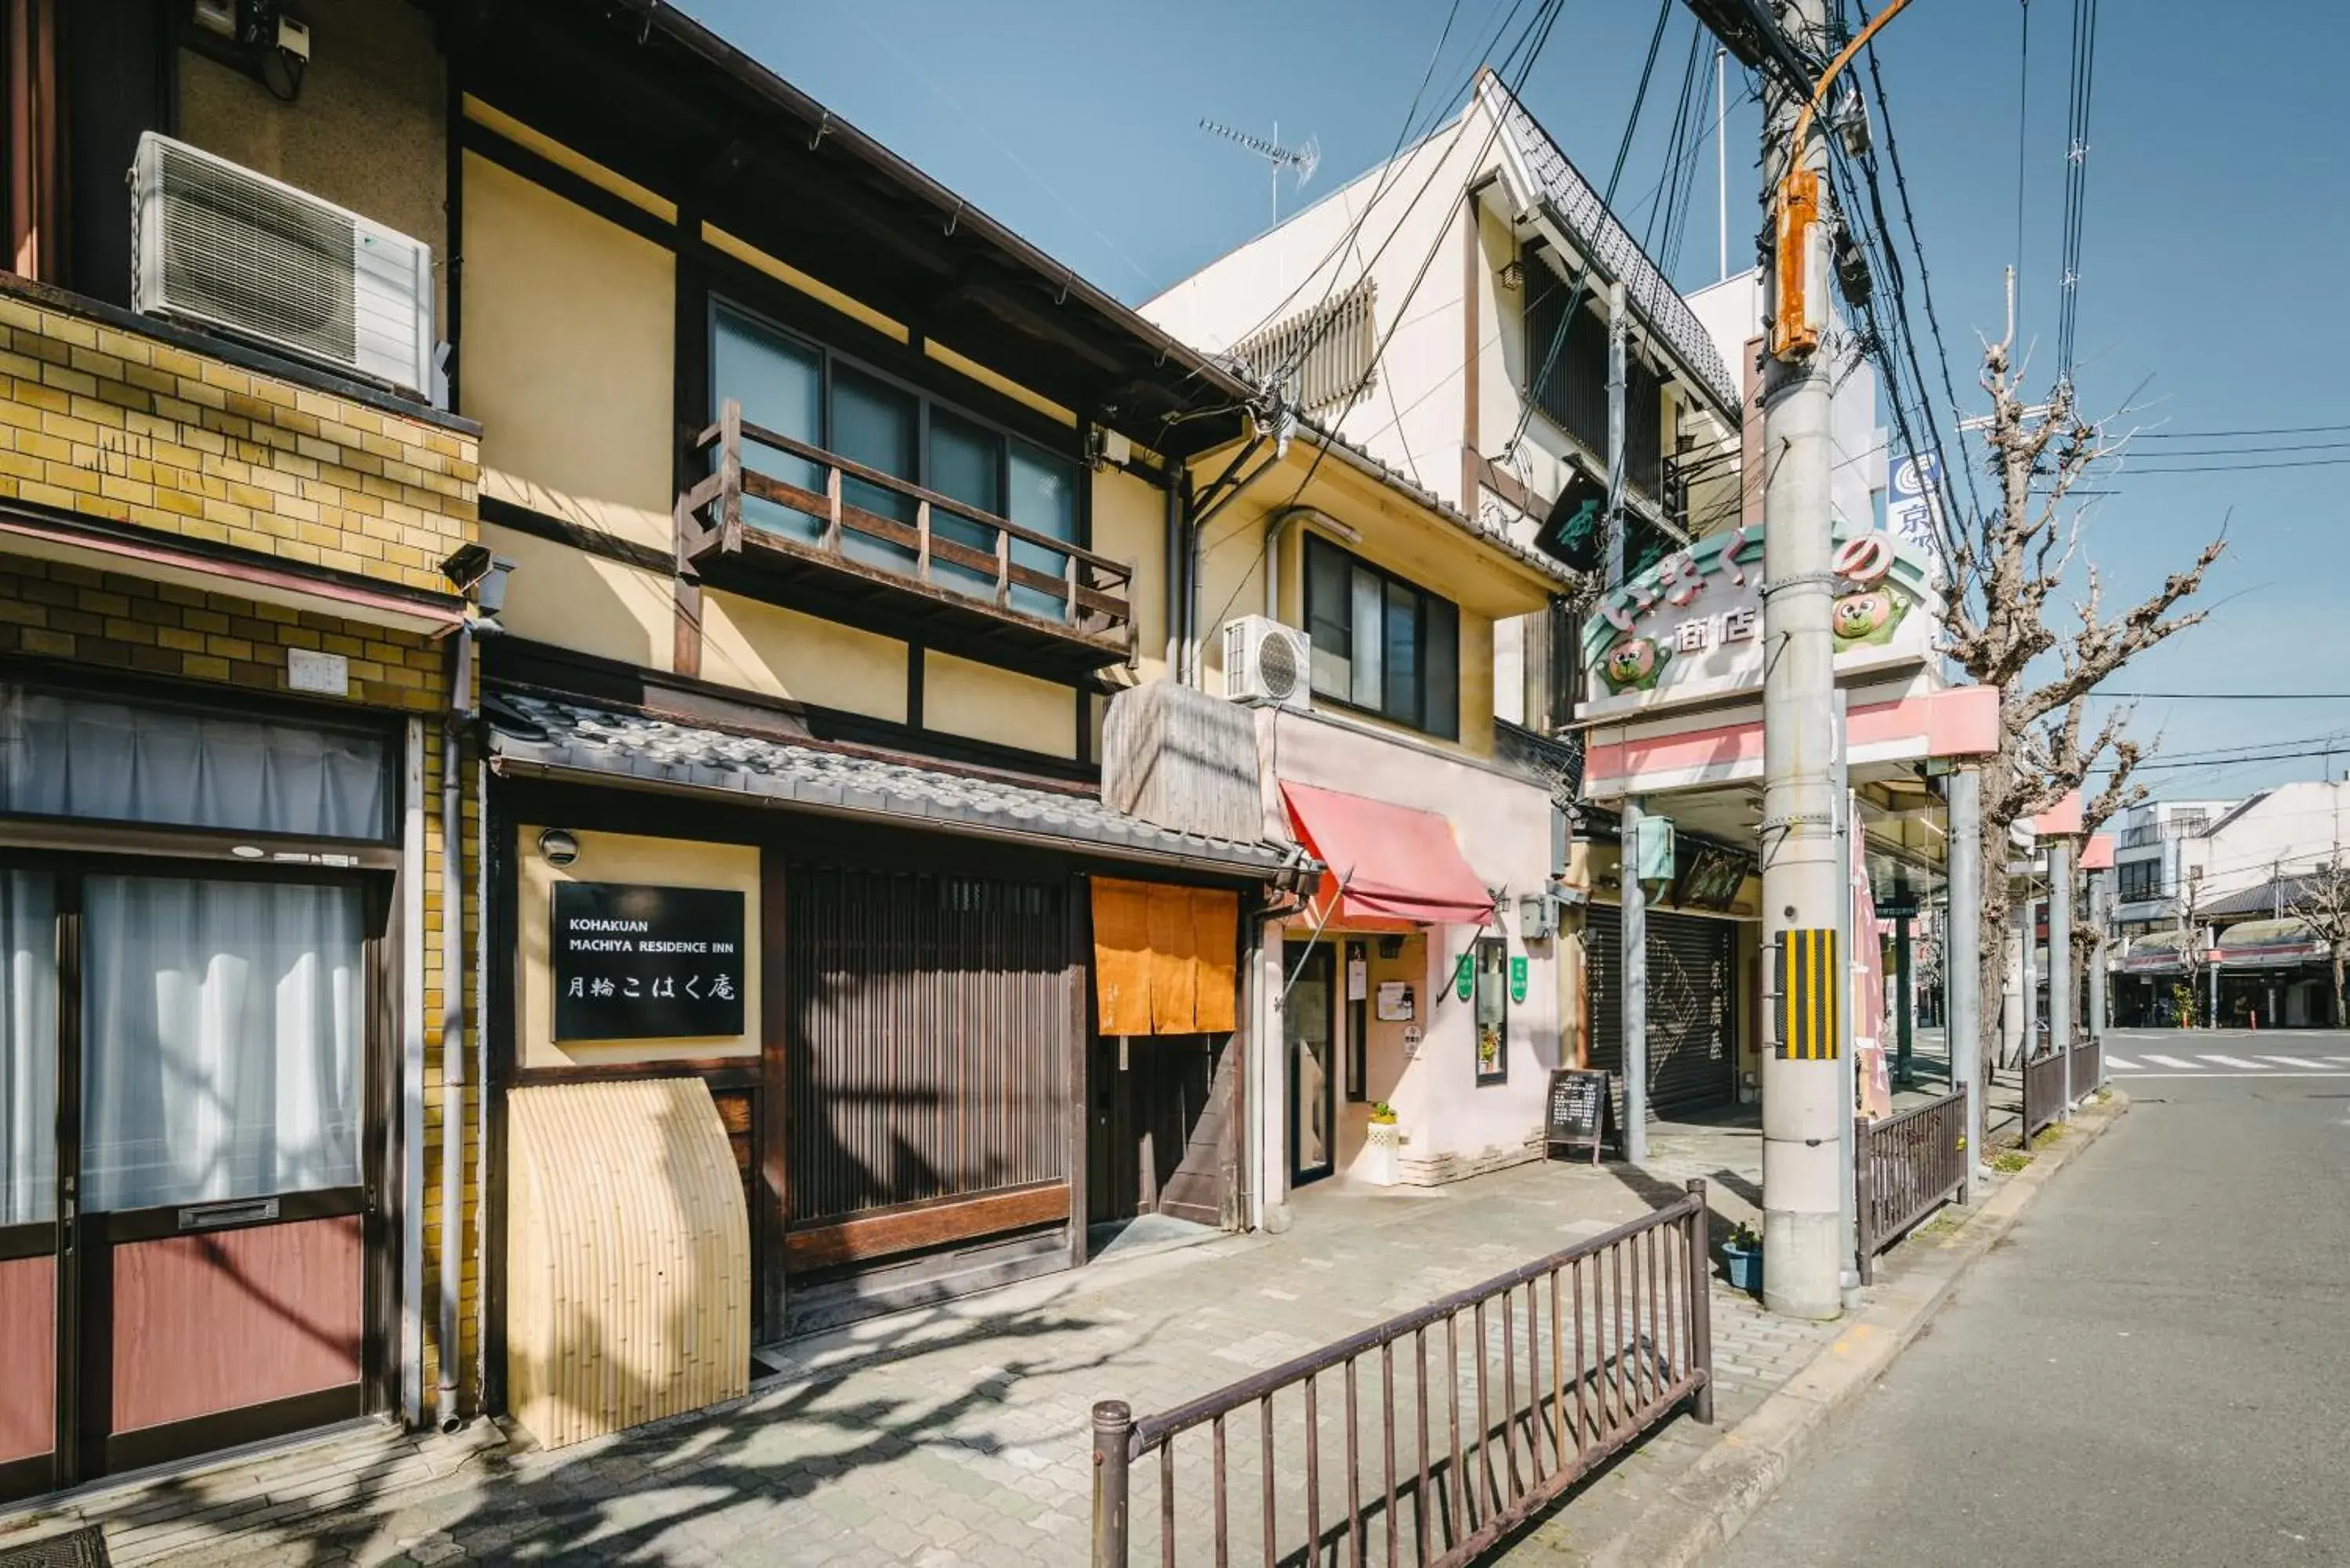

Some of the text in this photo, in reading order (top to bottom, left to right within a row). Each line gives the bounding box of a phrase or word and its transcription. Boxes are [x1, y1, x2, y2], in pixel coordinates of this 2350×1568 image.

[569, 918, 648, 932] KOHAKUAN
[569, 938, 734, 953] MACHIYA RESIDENCE INN
[568, 974, 735, 1000] 月輪こはく庵
